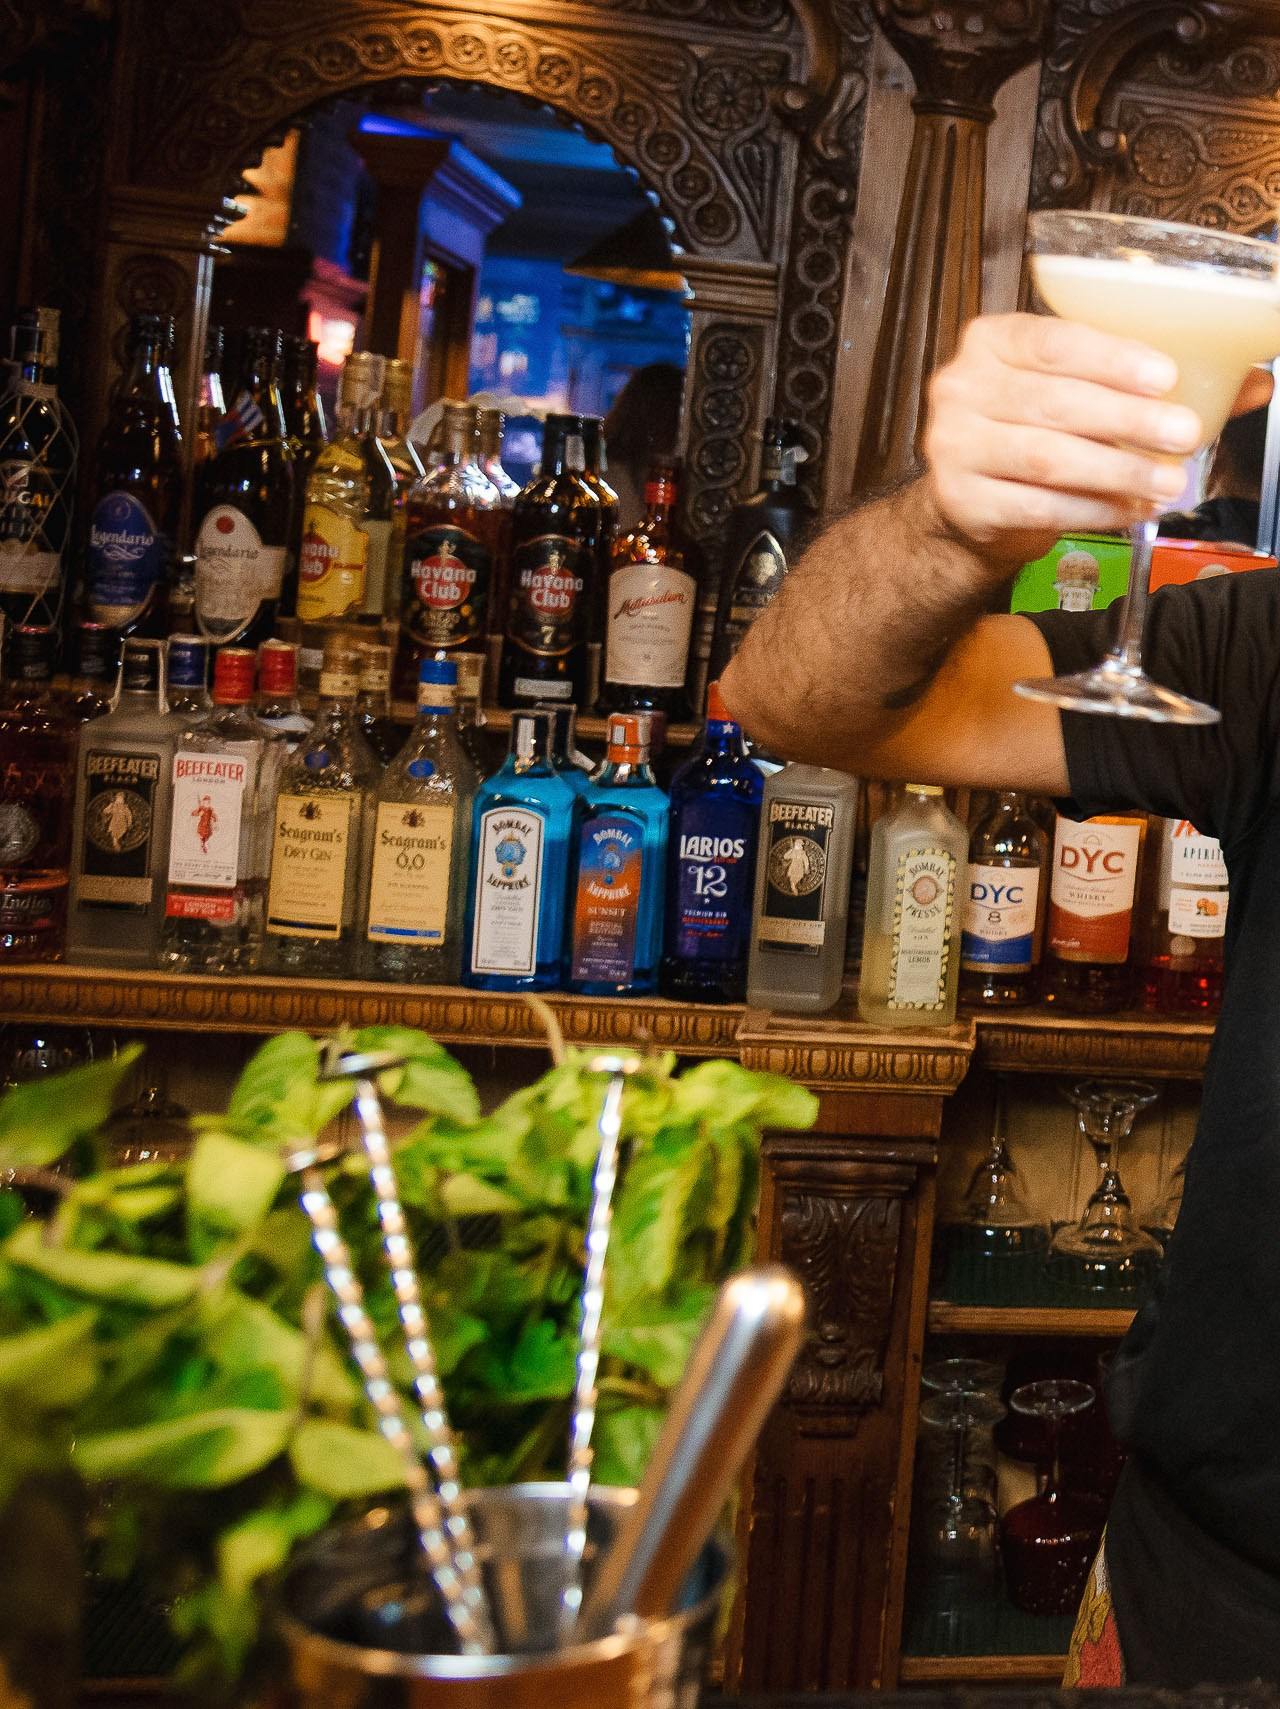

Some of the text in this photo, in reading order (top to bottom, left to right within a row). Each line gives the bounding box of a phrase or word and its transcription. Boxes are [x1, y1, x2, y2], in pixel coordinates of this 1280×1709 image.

[90, 523, 154, 549] Legendario
[410, 560, 477, 584] Havana
[520, 568, 584, 593] Havana
[420, 579, 461, 601] Club
[530, 587, 571, 609] Club
[541, 625, 557, 645] 7
[86, 756, 159, 781] BEEFEATER
[176, 759, 245, 783] BEEFEATER
[769, 803, 834, 829] BEEFEATER
[784, 821, 816, 832] BLACK
[279, 821, 343, 844] Seagram's
[381, 829, 447, 854] Seagram's
[283, 844, 309, 859] DRY
[680, 834, 746, 863] LARIOS
[1060, 844, 1126, 873] DYC
[687, 865, 728, 898] 12
[908, 862, 946, 877] BOMBAY
[969, 882, 1024, 904] DYC
[987, 911, 1002, 923] 8
